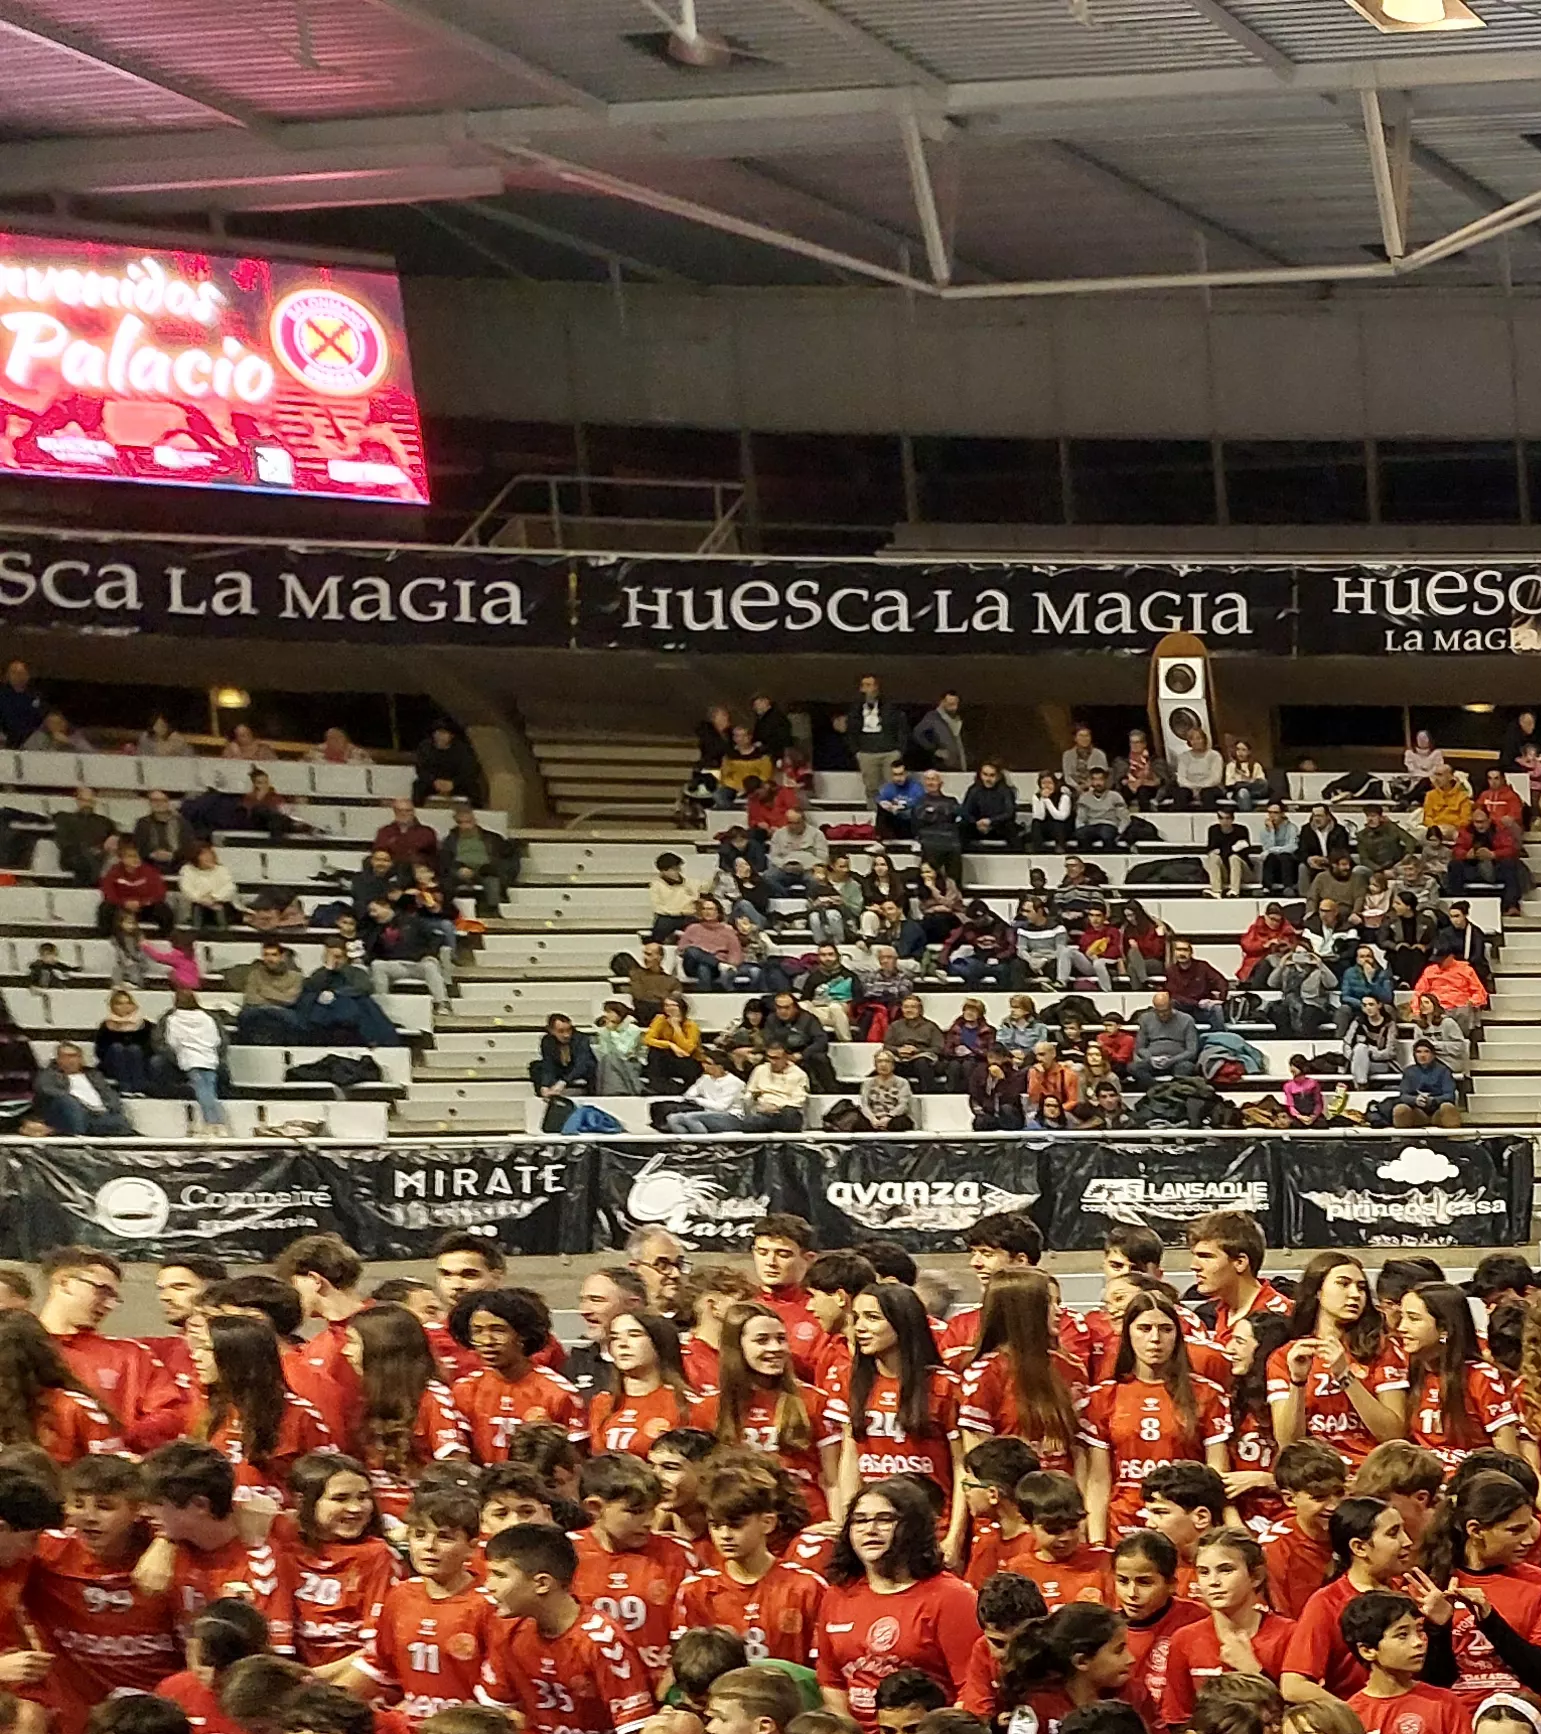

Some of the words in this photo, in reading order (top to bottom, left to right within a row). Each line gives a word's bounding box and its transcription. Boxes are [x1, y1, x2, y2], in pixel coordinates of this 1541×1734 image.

[0, 310, 275, 402] Palacio
[827, 1180, 983, 1205] avanza
[1139, 1417, 1160, 1442] 8
[859, 1454, 934, 1475] ASAOSA
[407, 1643, 441, 1674] 11
